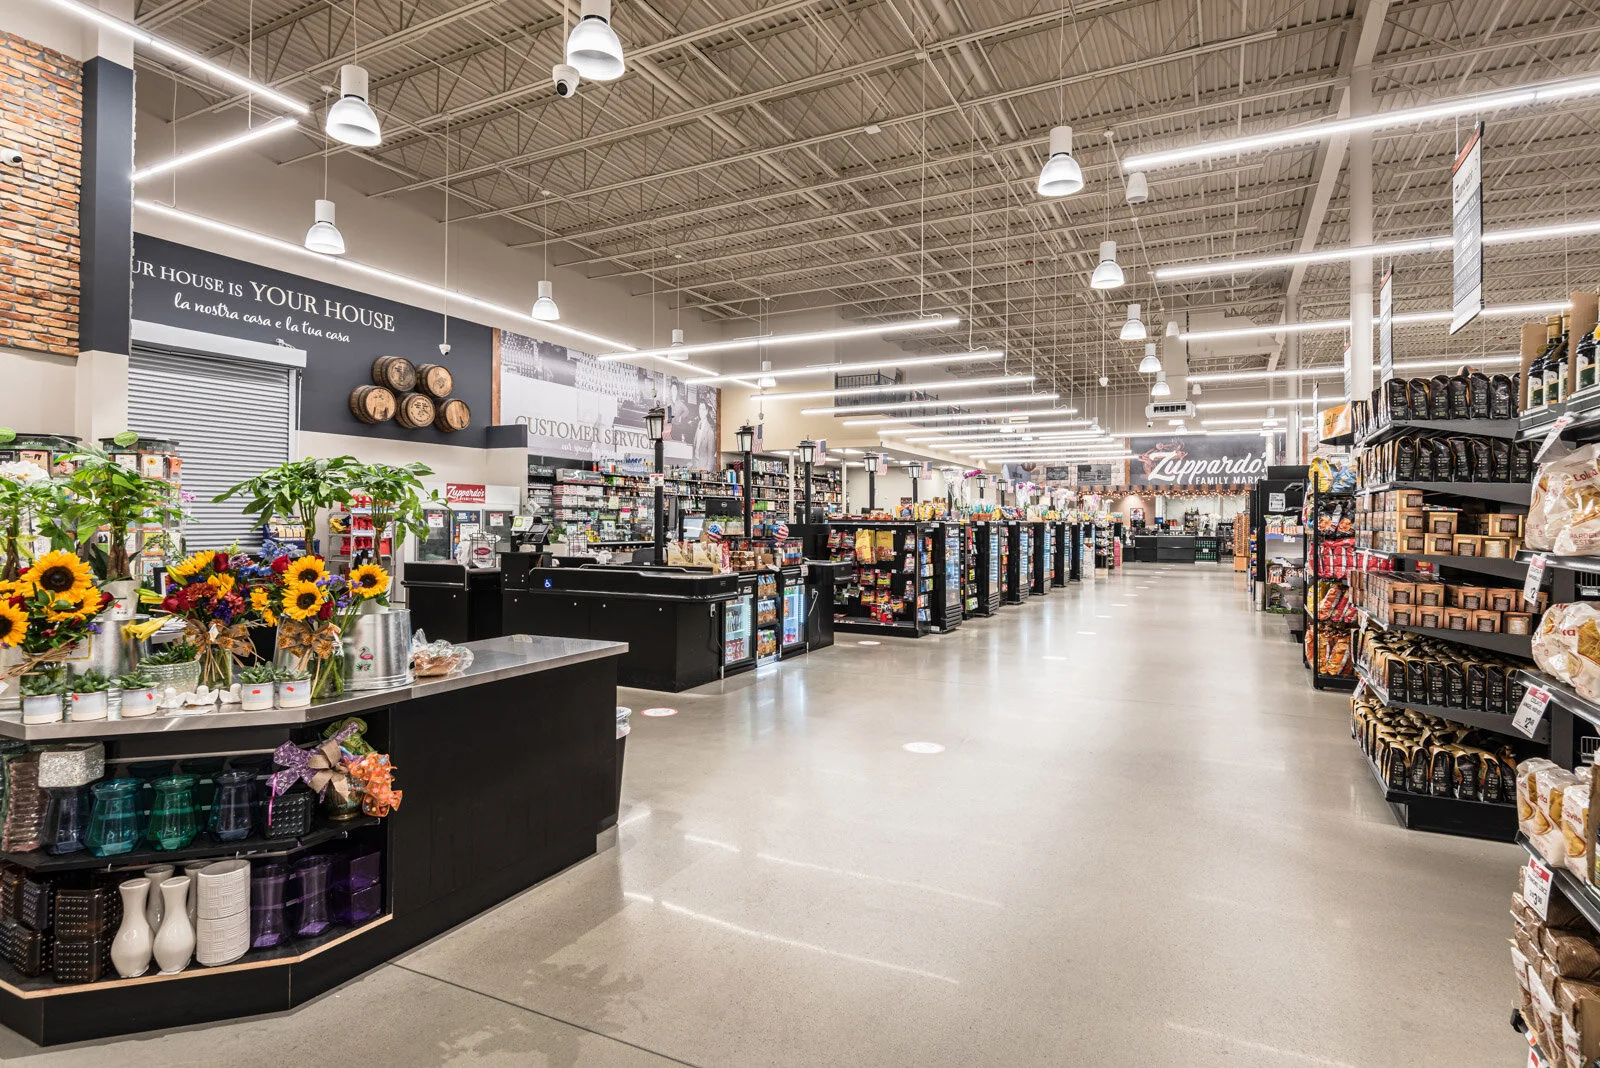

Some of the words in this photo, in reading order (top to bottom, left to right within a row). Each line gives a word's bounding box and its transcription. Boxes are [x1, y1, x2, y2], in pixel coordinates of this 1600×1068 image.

[131, 260, 157, 278] UR
[159, 266, 224, 293] HOUSE
[228, 282, 243, 297] IS
[250, 281, 319, 315] YOUR
[324, 299, 395, 332] HOUSE
[174, 292, 190, 311] la
[193, 302, 239, 321] nostra
[243, 314, 272, 328] casa
[275, 320, 282, 329] e
[286, 316, 299, 333] la
[302, 320, 322, 338] tua
[326, 331, 350, 344] casa
[514, 415, 602, 443] CUSTOMER
[604, 429, 656, 450] SERVICE
[447, 485, 485, 500] Zuppardo's
[1195, 476, 1228, 485] FAMILY
